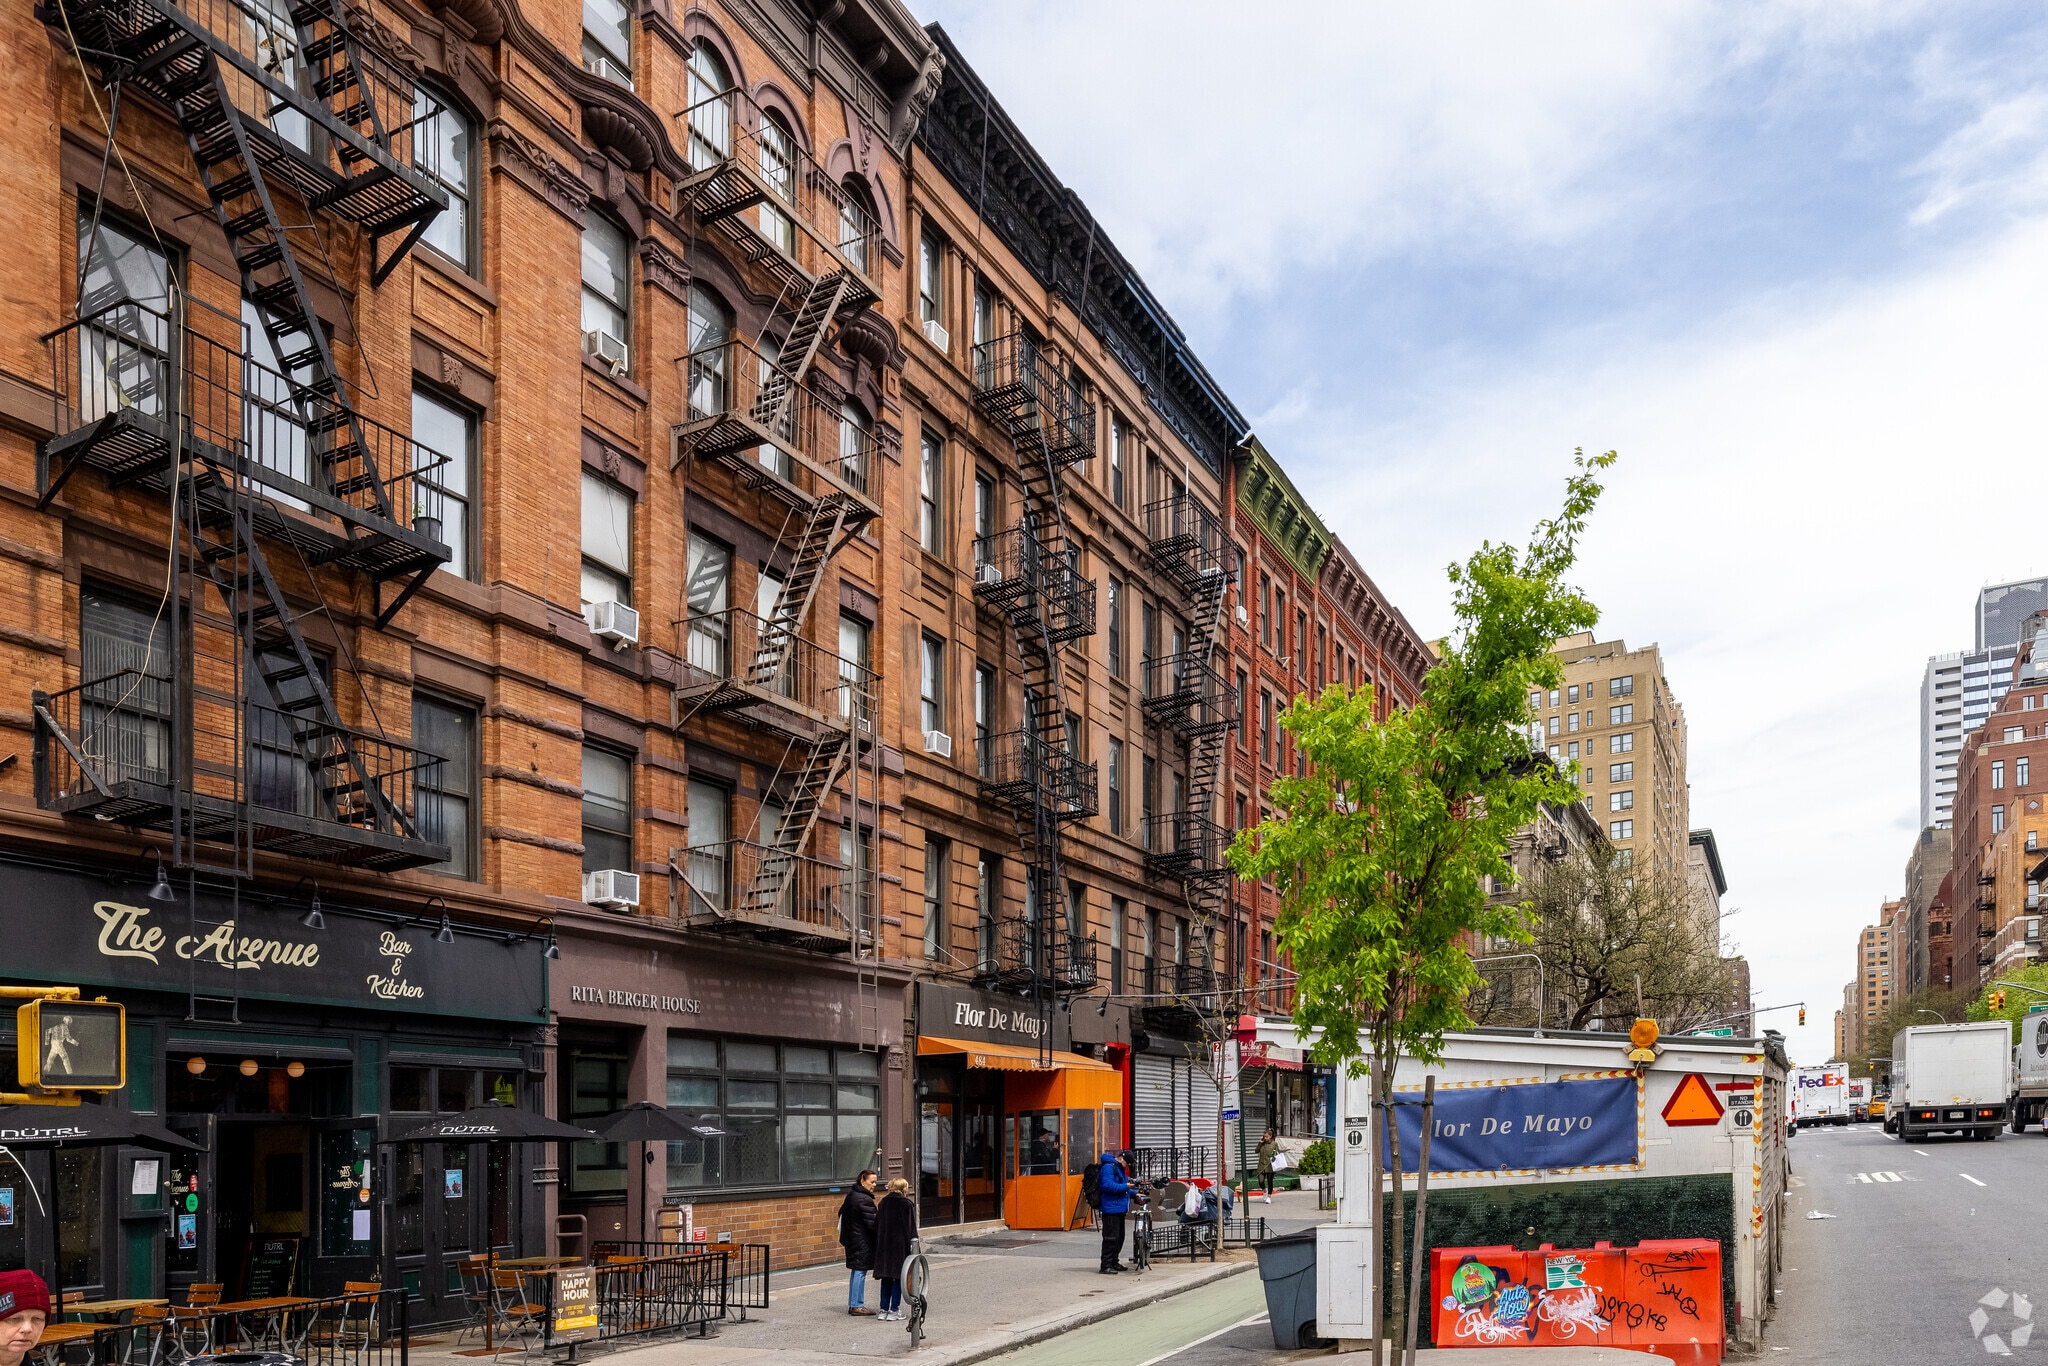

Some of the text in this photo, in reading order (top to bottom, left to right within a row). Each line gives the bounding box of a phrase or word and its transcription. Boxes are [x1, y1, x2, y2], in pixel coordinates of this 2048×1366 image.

[94, 901, 320, 970] The Avenue
[379, 931, 413, 957] Bar
[391, 958, 402, 975] &
[366, 974, 425, 1000] Kitchen
[572, 985, 701, 1014] RITA BERGER HOUSE
[955, 1002, 986, 1028] Flor
[988, 1007, 1008, 1030] De
[975, 1055, 986, 1067] 484
[1799, 1073, 1846, 1089] FedEx
[1419, 1114, 1593, 1138] lor De Mayo
[561, 1277, 590, 1290] HAPPY
[1500, 1284, 1529, 1302] Auto
[563, 1288, 589, 1301] HOUR
